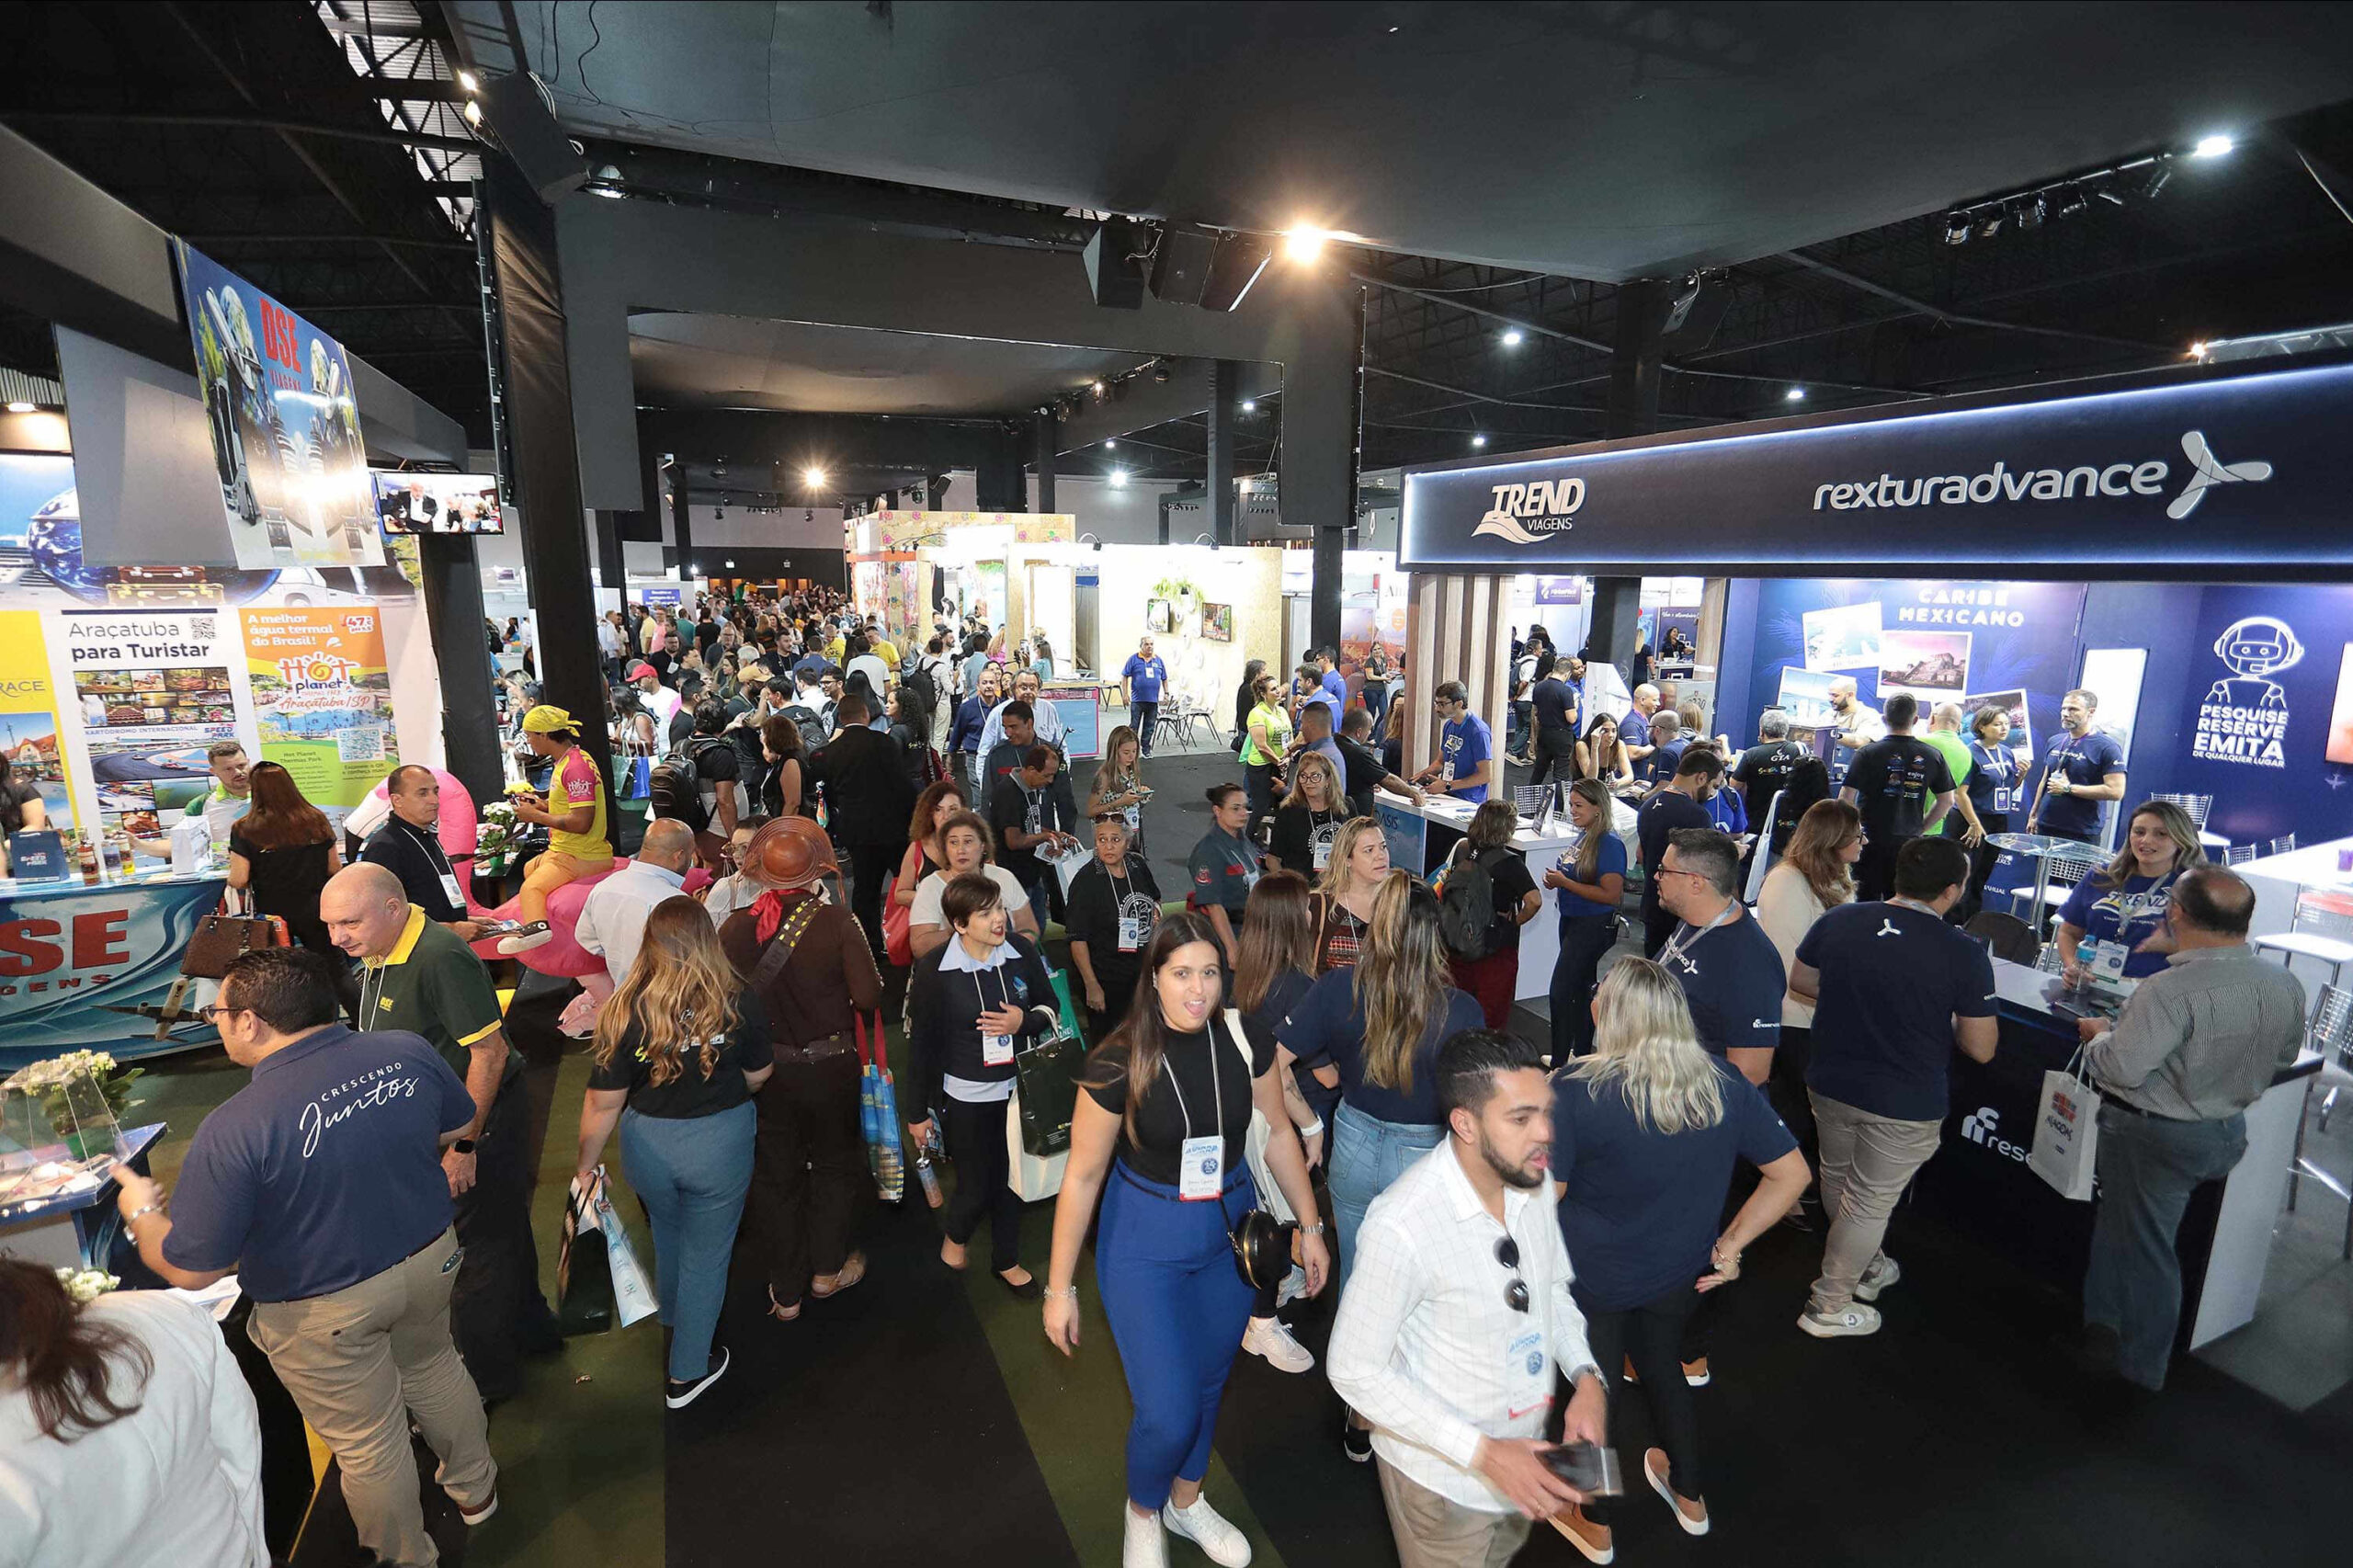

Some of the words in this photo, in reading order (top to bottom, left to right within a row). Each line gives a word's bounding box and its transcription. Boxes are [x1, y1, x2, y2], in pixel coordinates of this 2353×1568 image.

[260, 297, 301, 373] DSE
[1813, 461, 2168, 510] rexturadvance
[1492, 478, 1585, 519] TREND
[1528, 517, 1573, 530] VIAGENS
[1918, 588, 2009, 607] CARIBE
[248, 614, 258, 624] A
[261, 613, 308, 624] melhor
[1898, 608, 2025, 628] MEXICANO
[69, 621, 180, 640] Araçatuba
[250, 625, 286, 637] água
[289, 624, 335, 634] termal
[252, 636, 269, 646] do
[272, 635, 317, 646] Brasil!
[72, 647, 121, 662] para
[127, 642, 210, 659] Turistar
[296, 677, 345, 695] planet
[2200, 704, 2289, 725] PESQUISE
[2198, 717, 2286, 740] RESERVE
[2193, 732, 2285, 760] EMITA
[2192, 749, 2204, 757] DE
[2205, 751, 2254, 764] QUALQUER
[2254, 756, 2285, 768] LUGAR
[320, 1062, 404, 1102] CRESCENDO
[299, 1074, 420, 1159] Juntos
